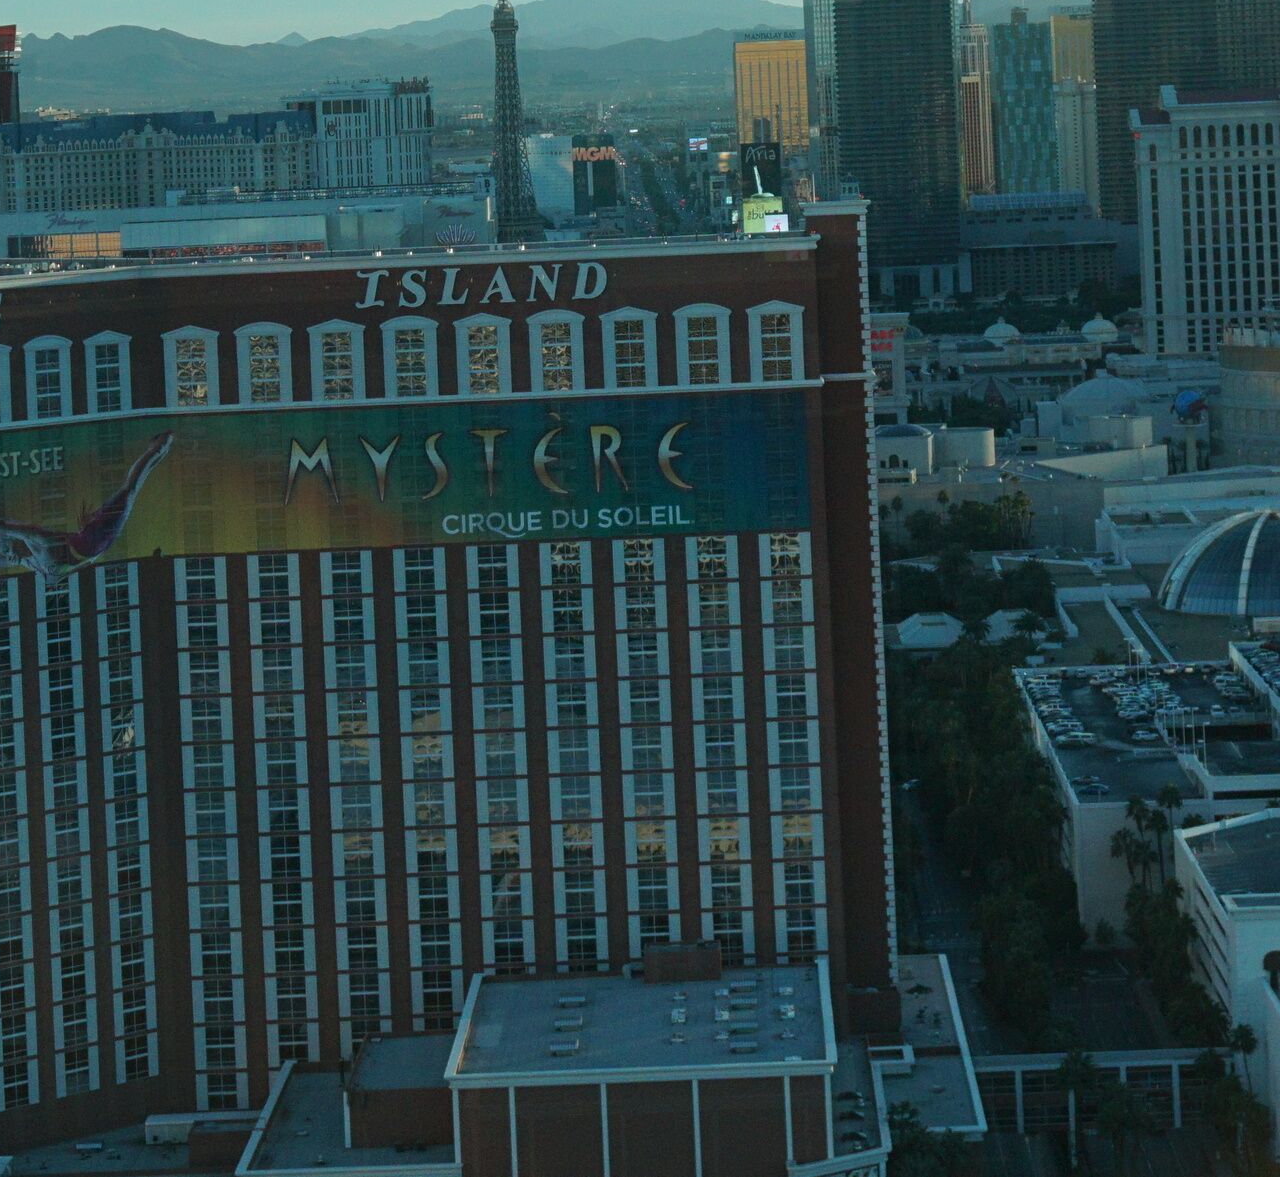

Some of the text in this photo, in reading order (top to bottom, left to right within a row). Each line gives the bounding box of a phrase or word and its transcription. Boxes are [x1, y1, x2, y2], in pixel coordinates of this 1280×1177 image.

[744, 31, 797, 41] MANDALAY BAY
[572, 146, 617, 161] MGM
[355, 261, 608, 309] ISLAND
[442, 504, 692, 539] CIRQUE DU SOLEIL
